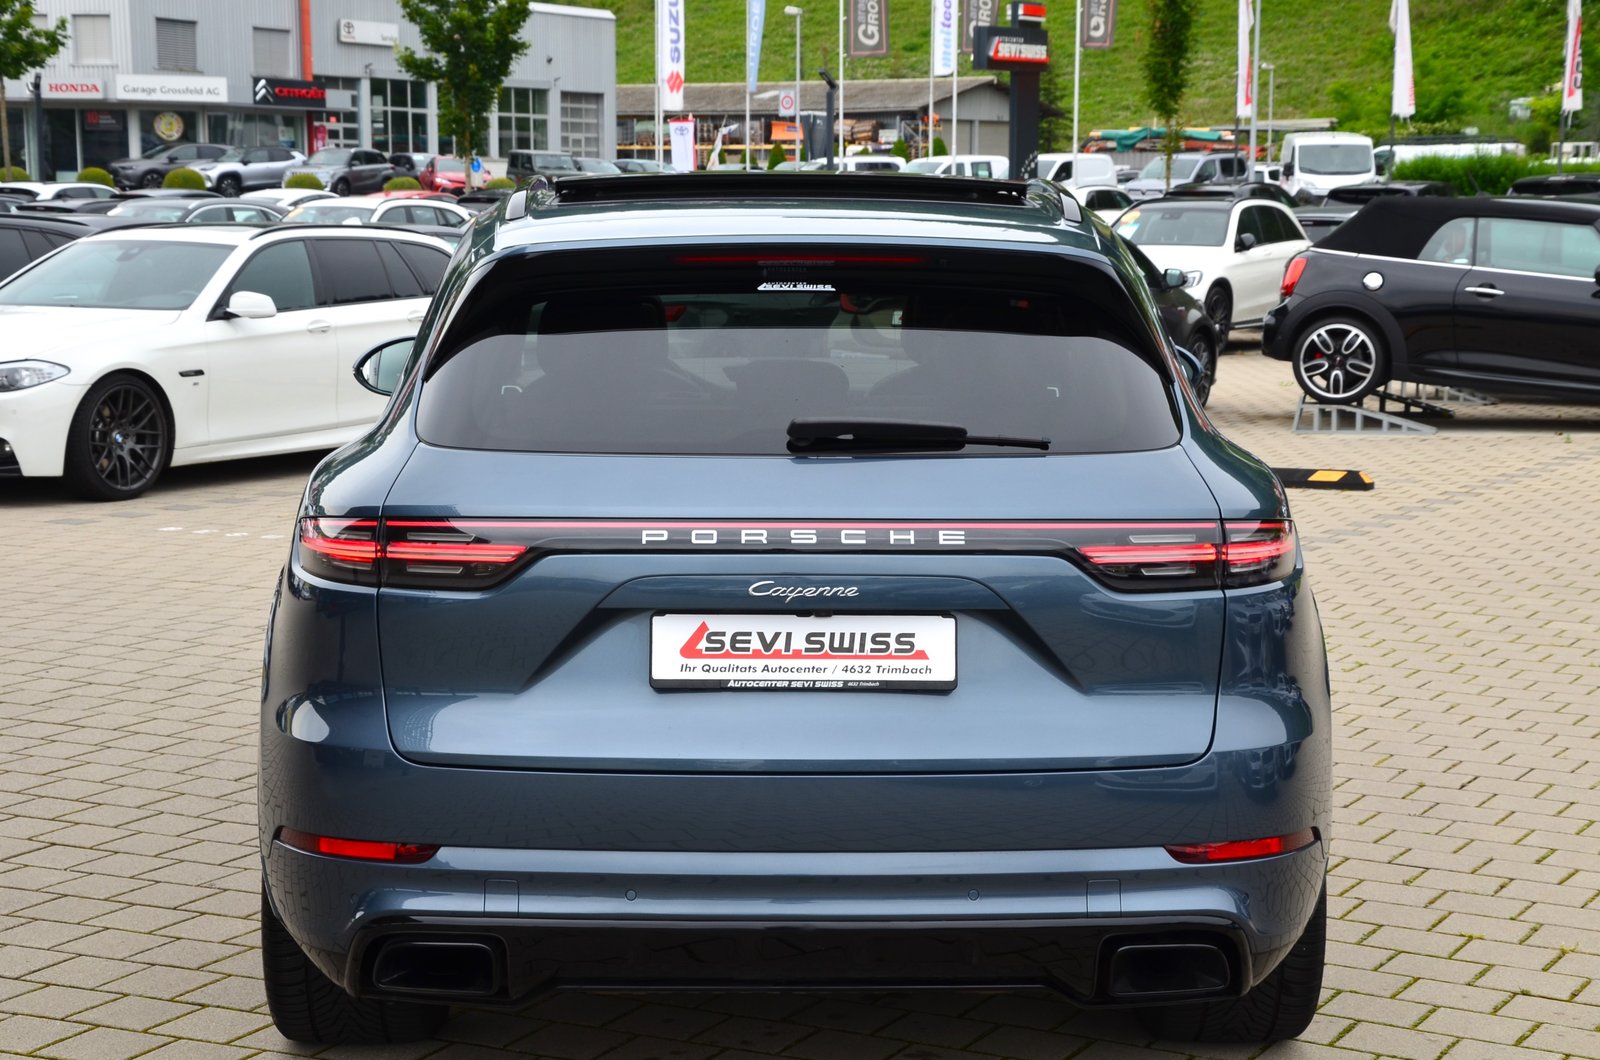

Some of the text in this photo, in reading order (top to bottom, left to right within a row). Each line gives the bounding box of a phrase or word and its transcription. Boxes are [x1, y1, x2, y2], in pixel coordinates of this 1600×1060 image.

[857, 0, 880, 46] GRO
[48, 83, 100, 93] HONDA
[123, 84, 220, 96] Garage Grossfeld AG
[641, 530, 966, 544] PORSCHE
[748, 580, 860, 603] Cayenne
[704, 631, 916, 654] SEVI SWISS
[680, 663, 932, 675] Ihr Qualitats Autocenter / 4632 Trimbach
[790, 680, 813, 688] SEVI
[814, 680, 844, 688] SWISS
